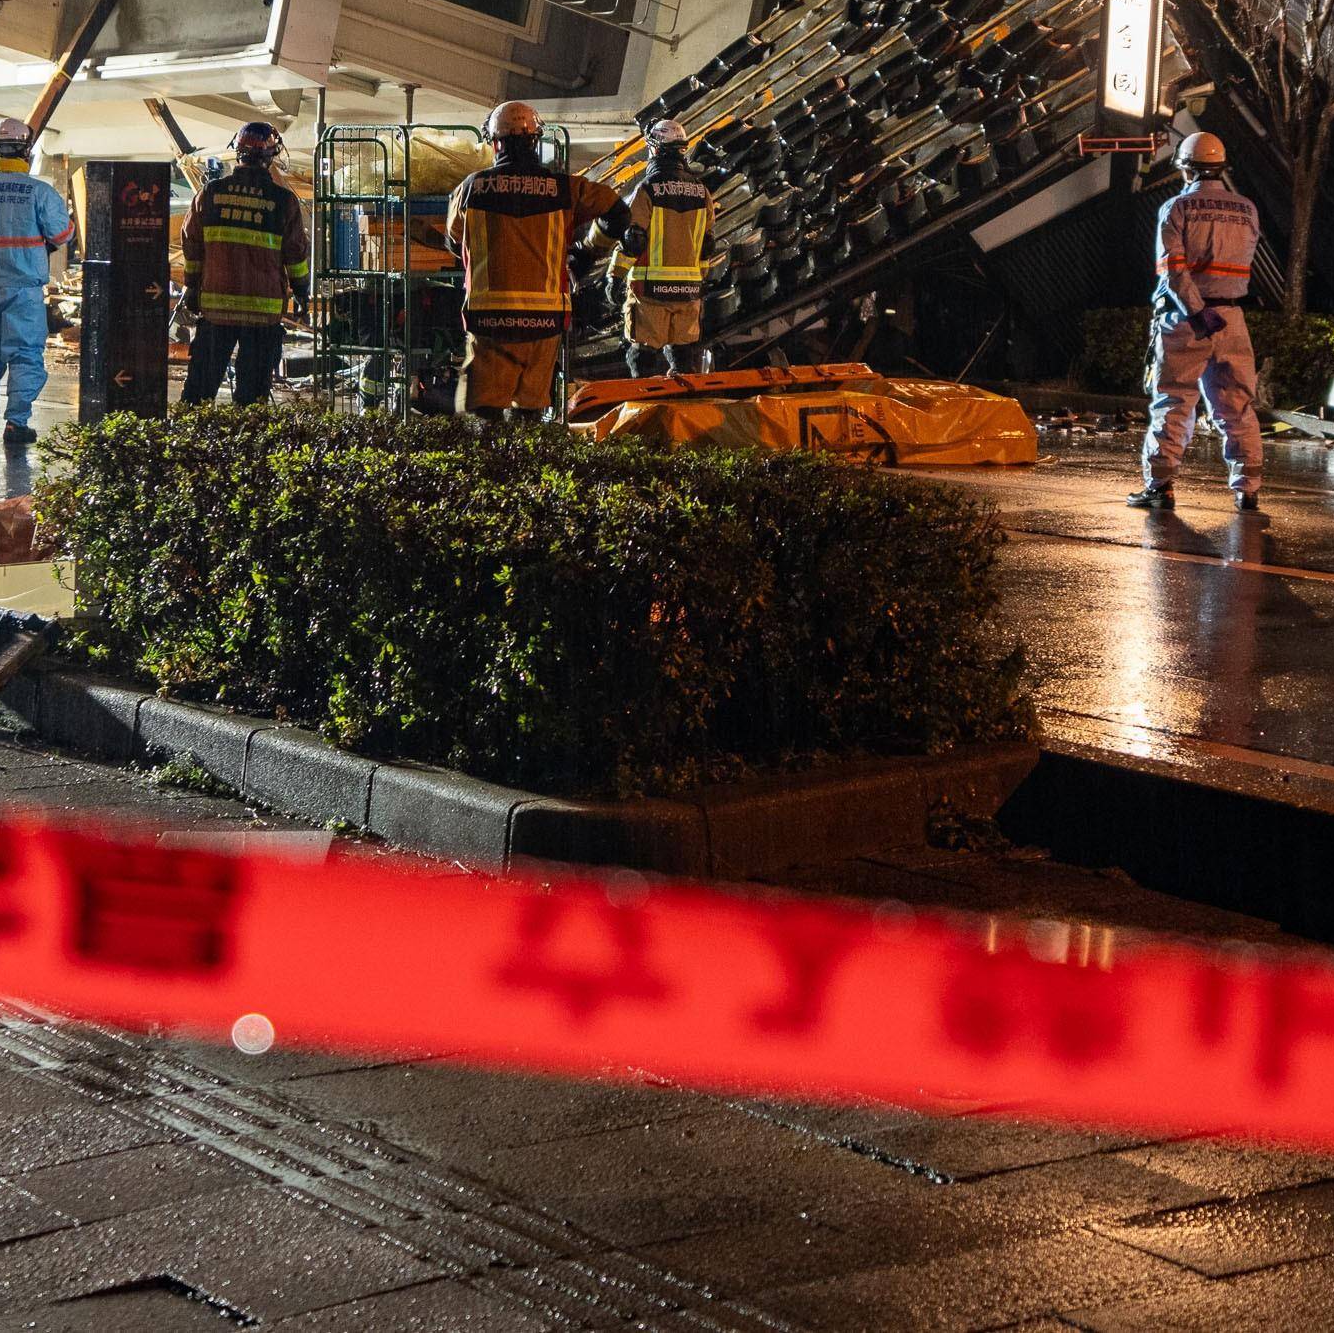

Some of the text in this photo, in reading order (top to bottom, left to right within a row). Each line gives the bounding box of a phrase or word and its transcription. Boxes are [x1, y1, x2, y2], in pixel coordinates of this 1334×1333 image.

[473, 174, 558, 197] 東大阪市消防局
[651, 180, 706, 198] 東大阪市消防局
[478, 316, 556, 328] HIGASHIOSAKA
